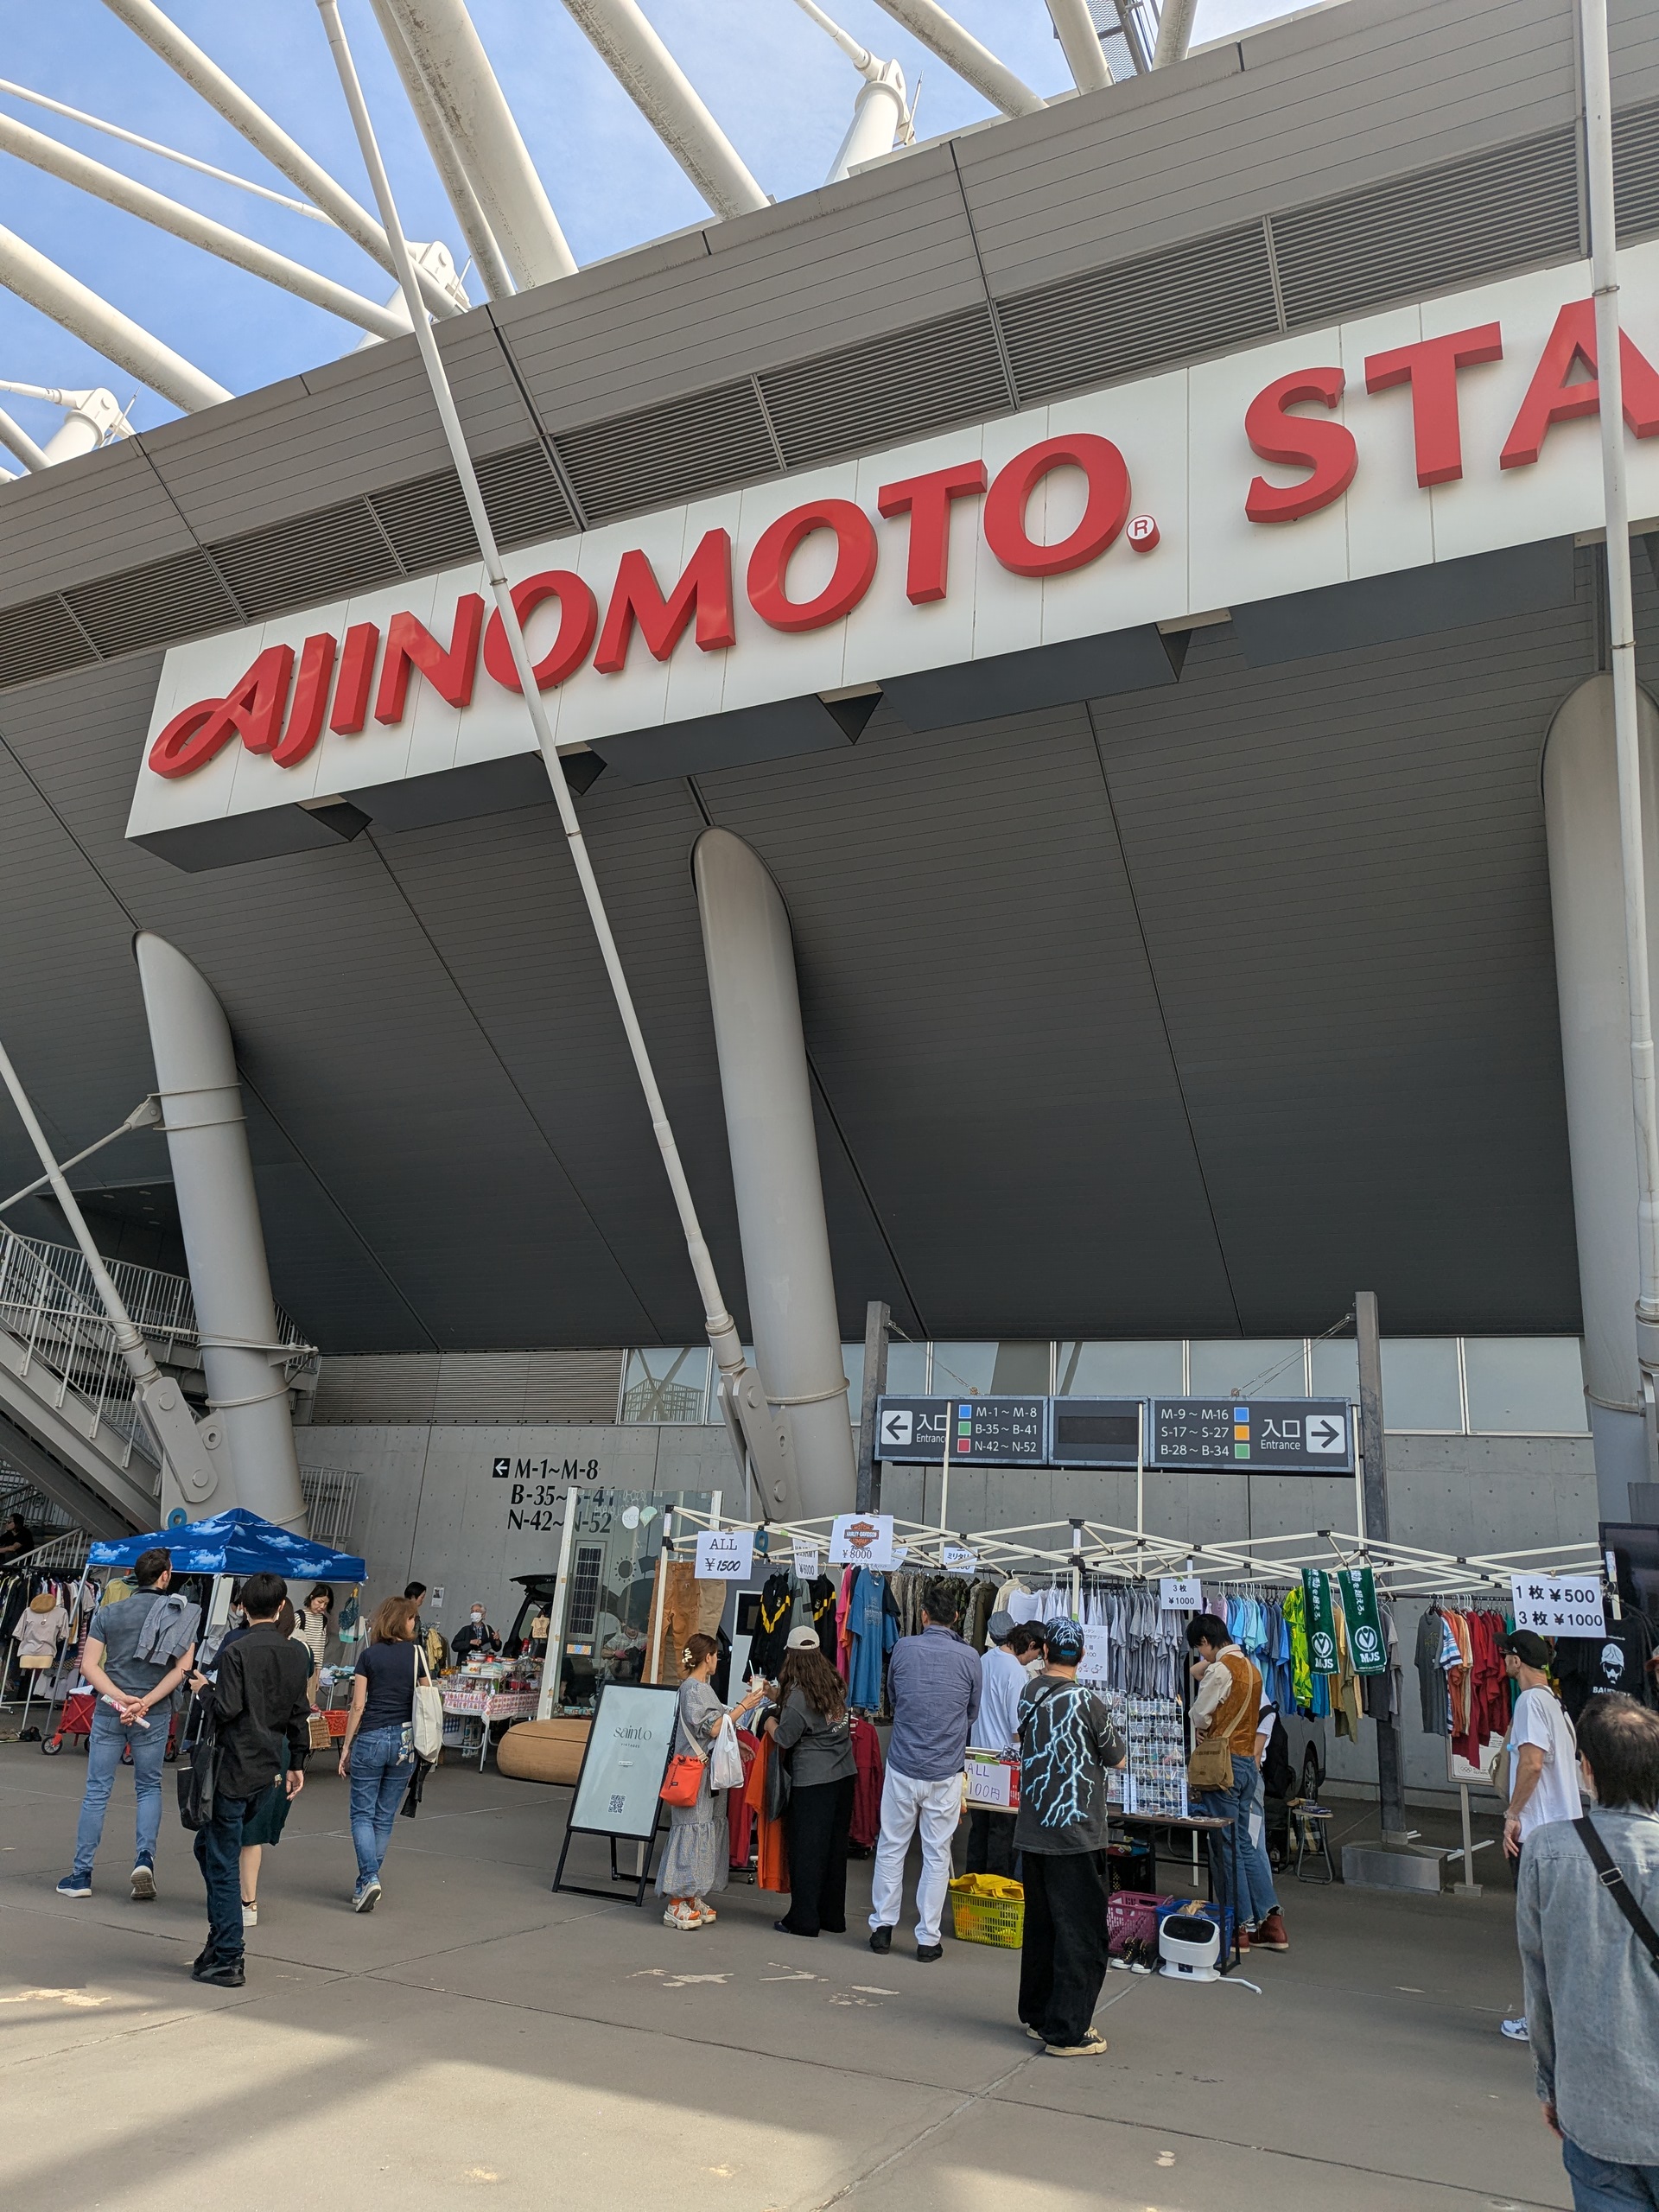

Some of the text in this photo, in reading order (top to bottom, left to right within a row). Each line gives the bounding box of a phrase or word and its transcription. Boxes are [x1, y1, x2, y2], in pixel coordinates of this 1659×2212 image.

[148, 432, 1132, 779] AJINOMOTO
[1261, 1419, 1301, 1439] 入口
[916, 1433, 947, 1443] Entranc
[1261, 1440, 1301, 1451] Entrance
[709, 1538, 738, 1551] ALL
[1314, 1657, 1334, 1669] MJS
[1359, 1651, 1381, 1663] MJS
[967, 1763, 990, 1777] ALL
